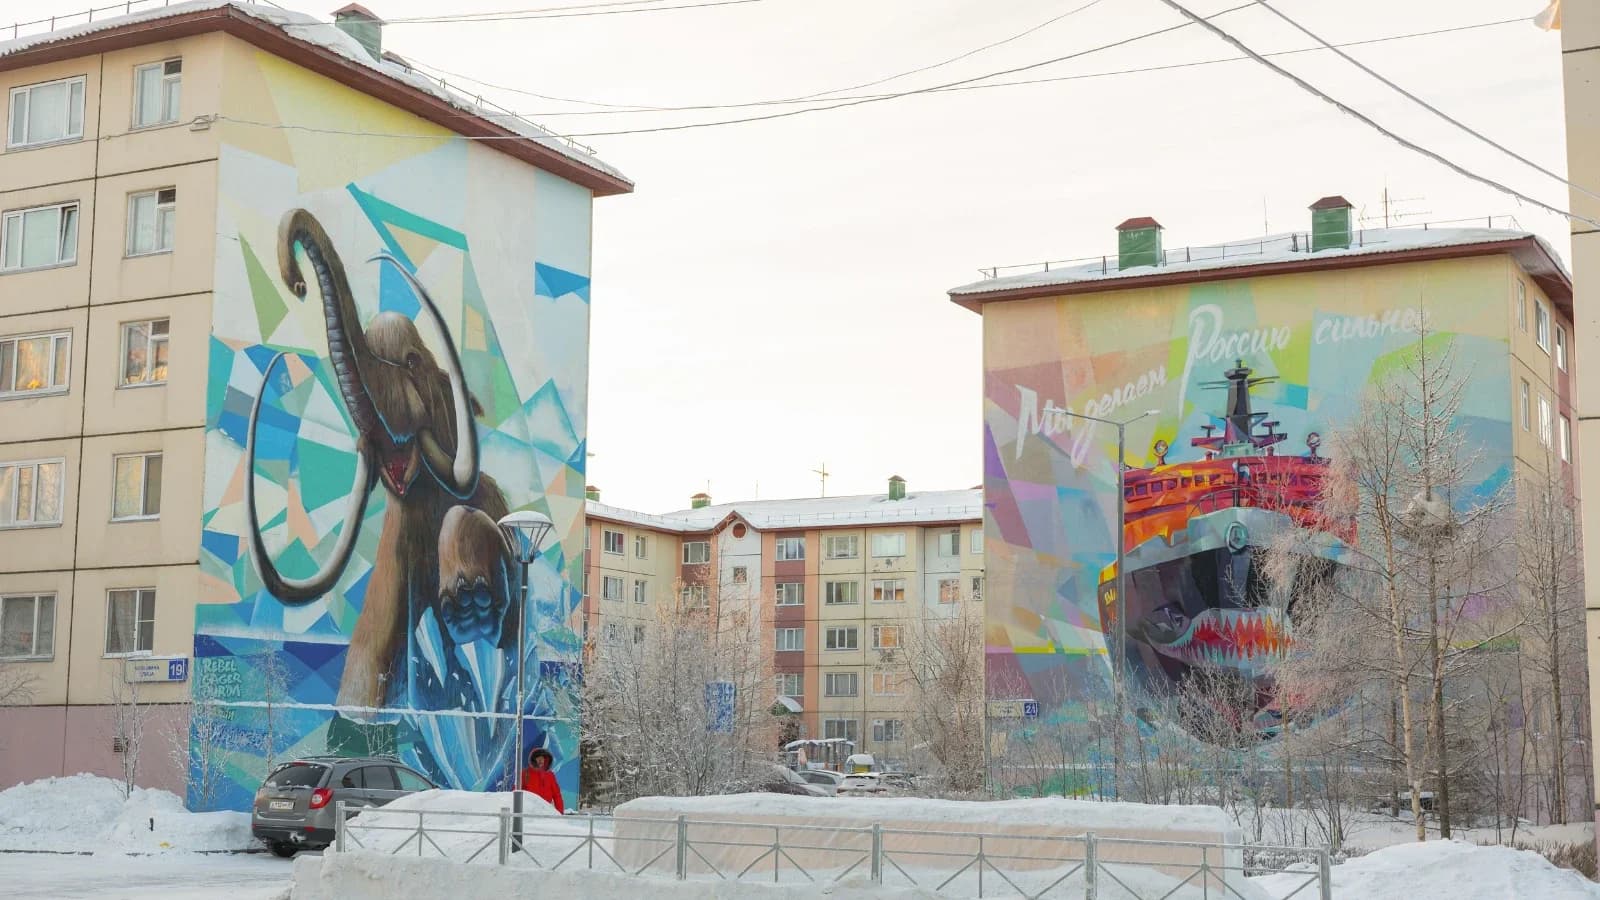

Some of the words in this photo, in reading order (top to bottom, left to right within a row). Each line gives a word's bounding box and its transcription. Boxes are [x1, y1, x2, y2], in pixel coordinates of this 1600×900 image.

[1015, 384, 1074, 460] Мы
[1071, 364, 1168, 469] делаем
[1175, 304, 1291, 424] Россию
[169, 663, 183, 676] 19
[202, 657, 237, 673] REBEL
